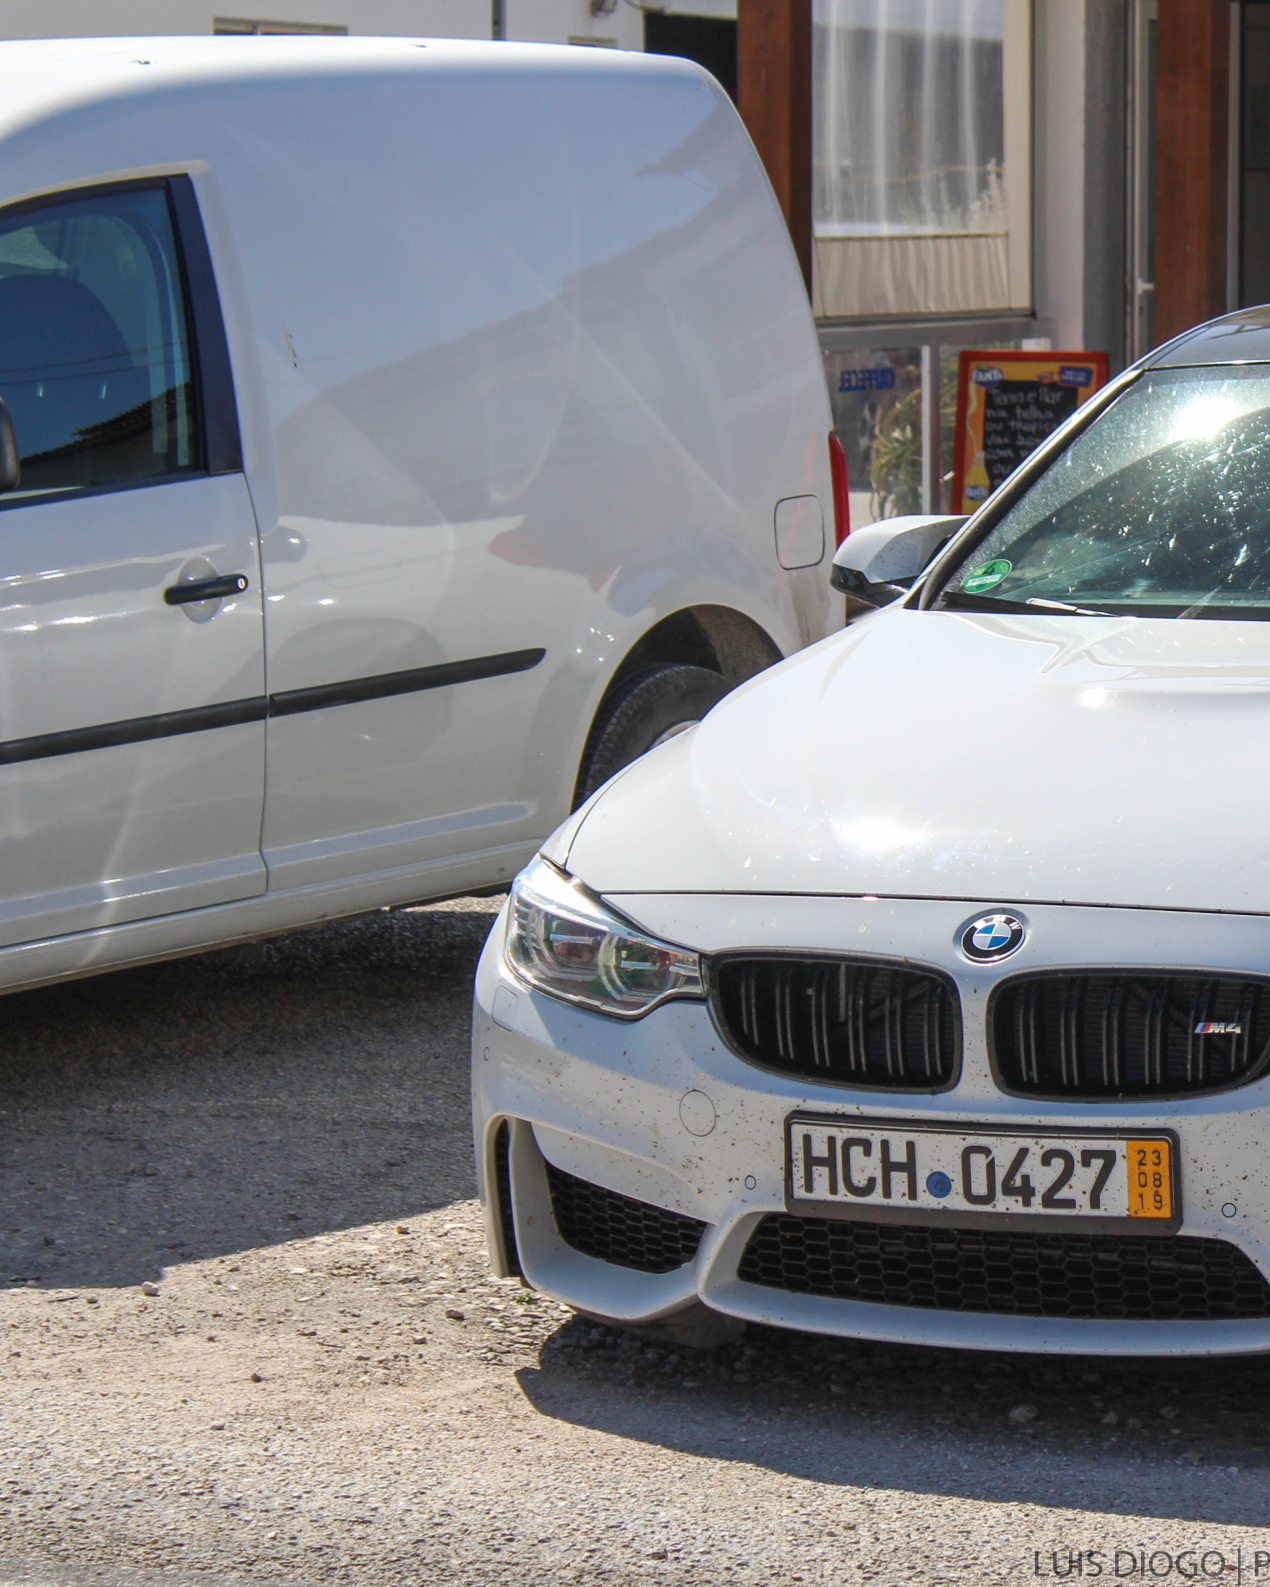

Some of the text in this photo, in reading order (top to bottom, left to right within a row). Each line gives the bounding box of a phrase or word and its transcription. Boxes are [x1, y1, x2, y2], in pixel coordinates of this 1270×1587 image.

[982, 562, 996, 575] 4
[1208, 1022, 1242, 1034] M4
[1137, 1149, 1161, 1166] 23
[802, 1134, 1117, 1210] HCH 0427
[1138, 1172, 1162, 1188] 08
[1139, 1193, 1163, 1210] 19
